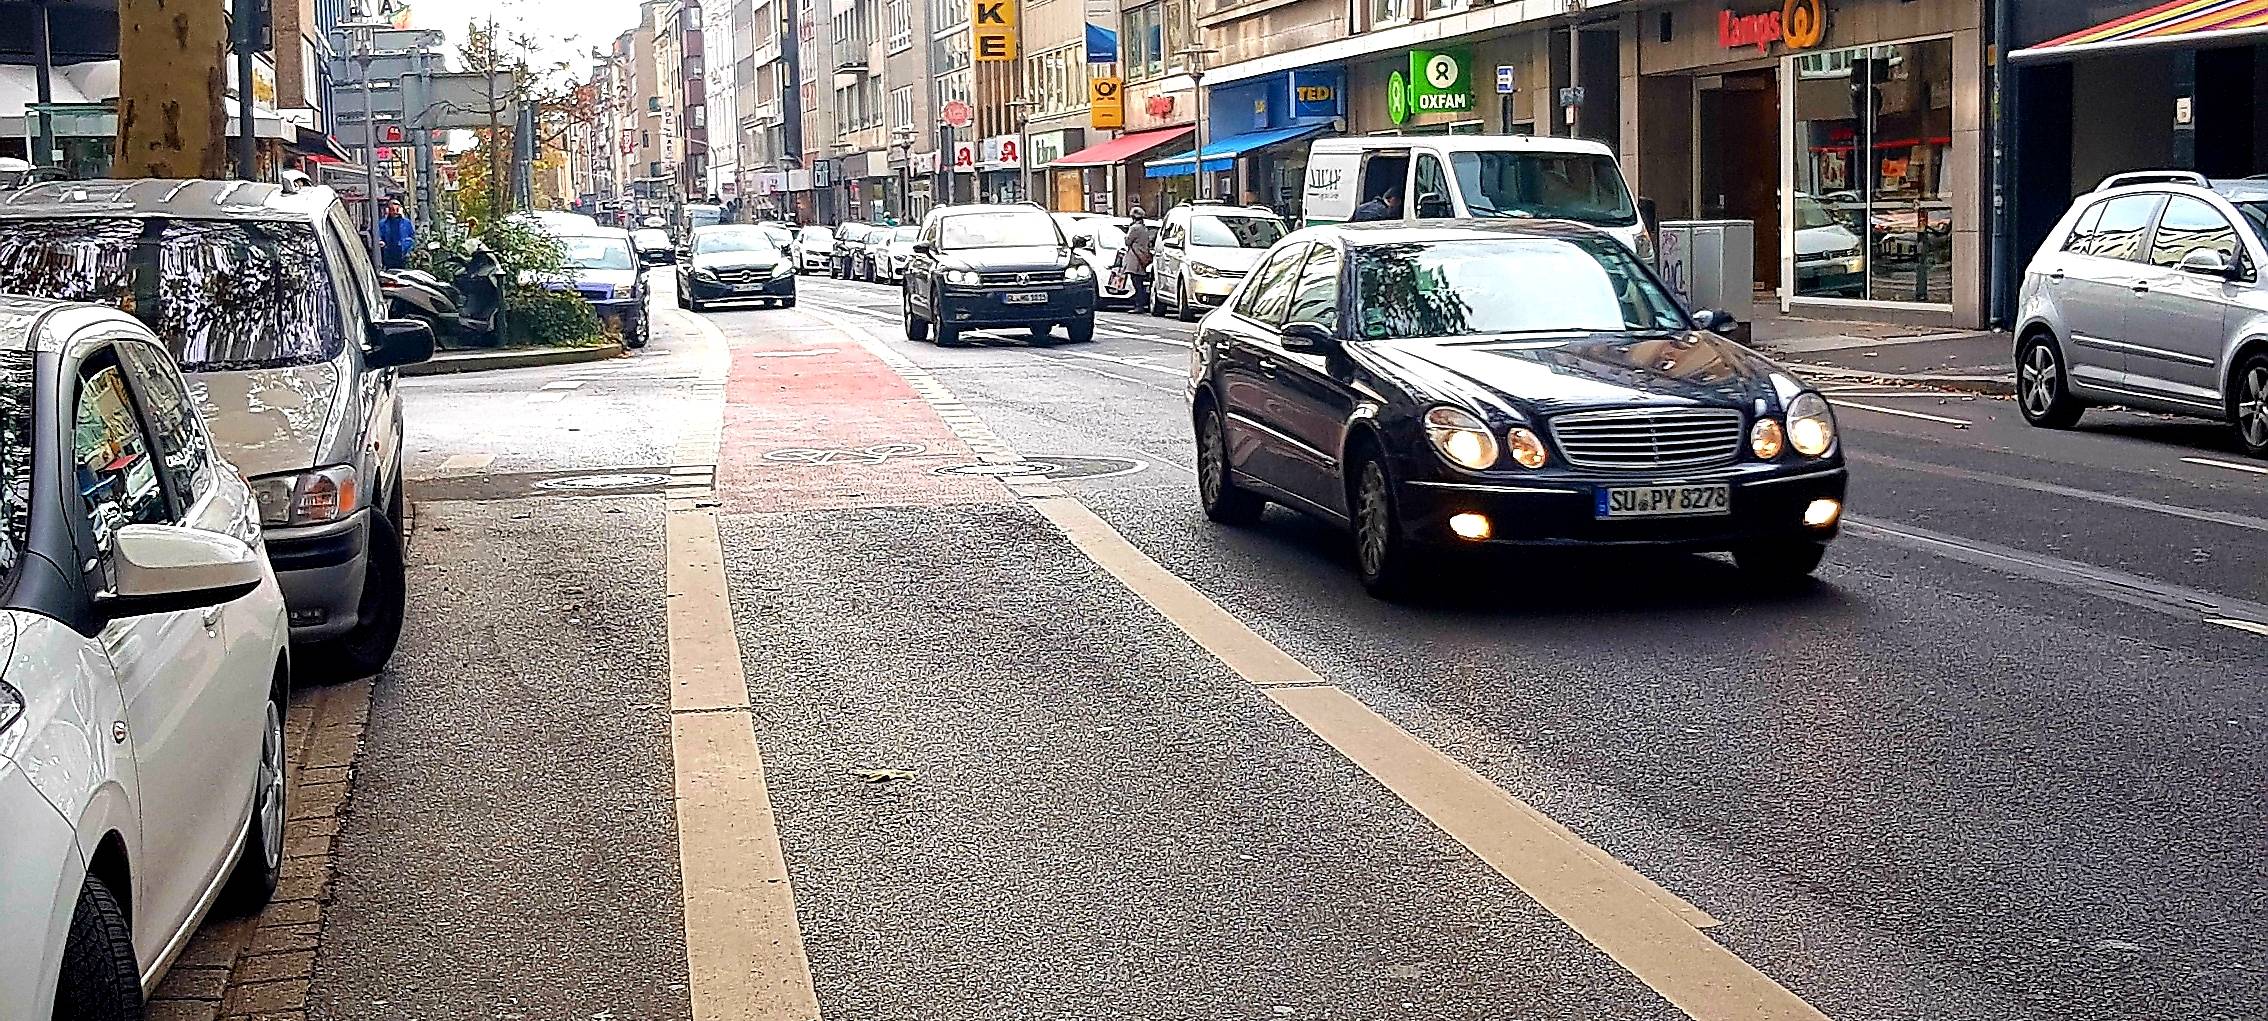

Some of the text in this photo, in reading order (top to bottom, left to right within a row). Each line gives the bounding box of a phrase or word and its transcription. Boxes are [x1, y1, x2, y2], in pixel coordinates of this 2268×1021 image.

[1420, 94, 1466, 109] OXFAM
[1610, 486, 1726, 511] SU PY 8278
